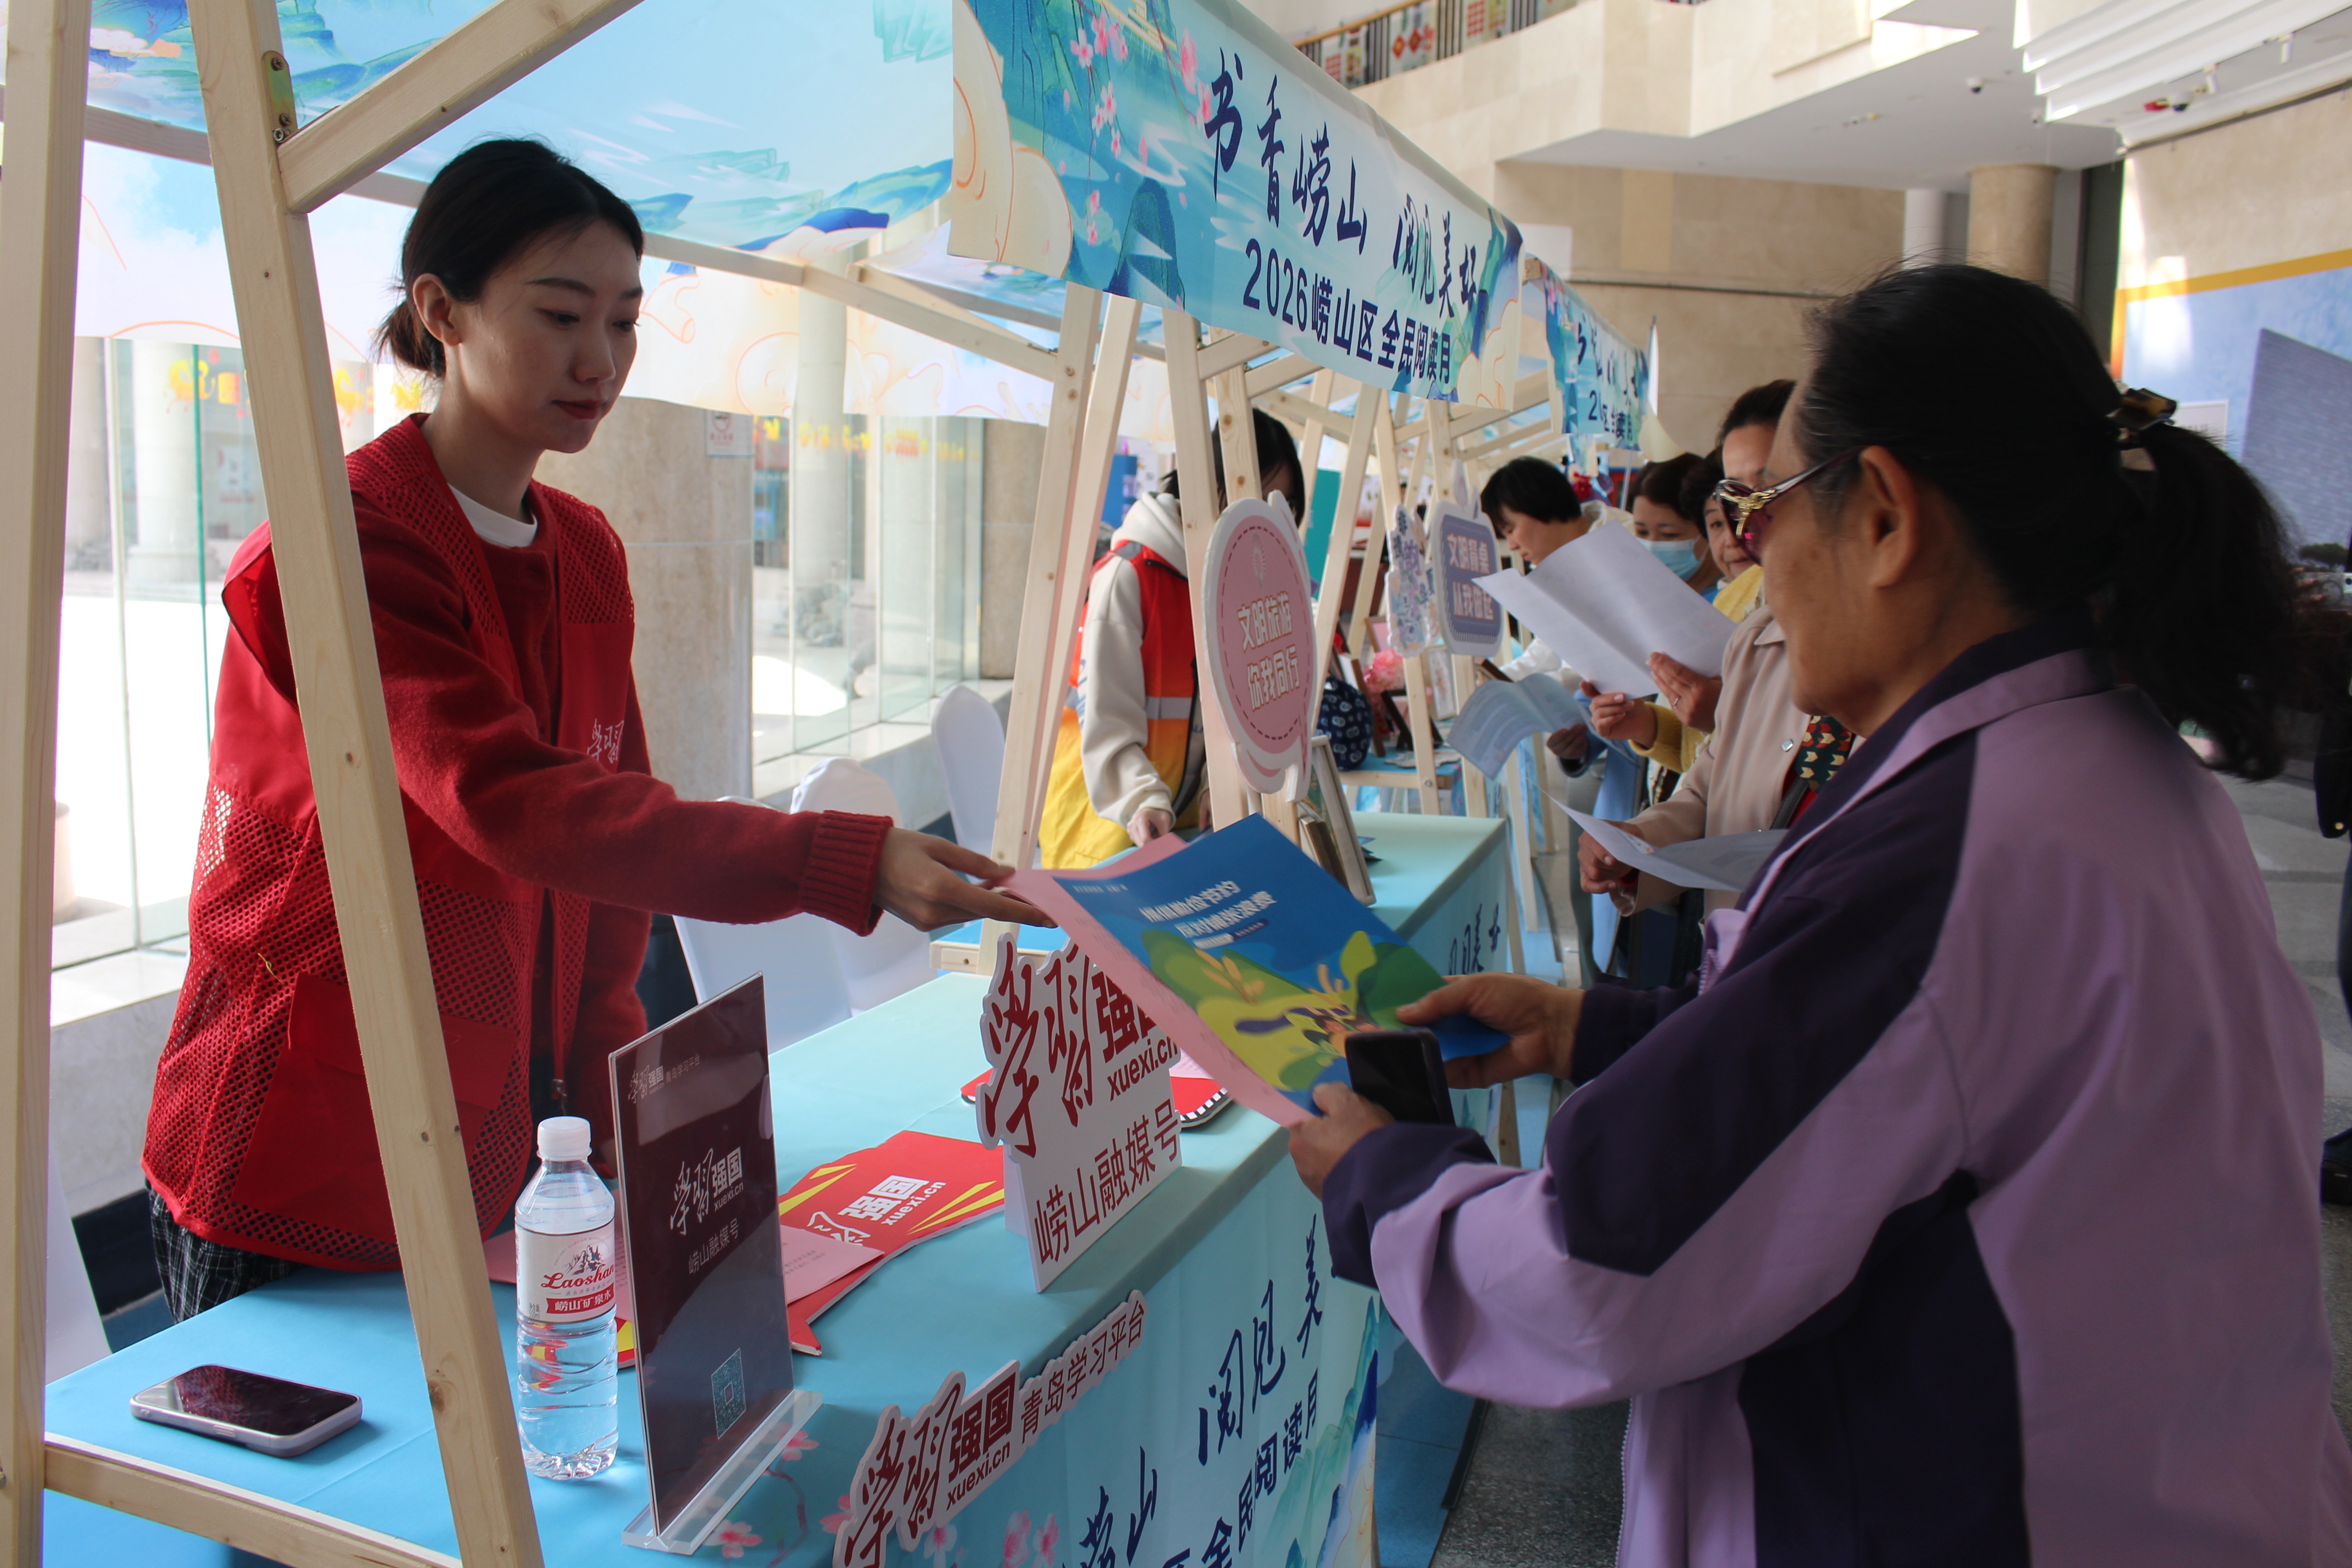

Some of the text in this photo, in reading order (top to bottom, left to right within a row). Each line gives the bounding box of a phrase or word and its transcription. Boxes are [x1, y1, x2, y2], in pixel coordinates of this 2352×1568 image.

[1205, 47, 1478, 318] 书香崂山 阅见美好
[1243, 238, 1450, 384] 2026崂山区全民阅读月
[1447, 533, 1490, 575] 文明餐桌
[1237, 591, 1292, 652] 文明旅游
[1246, 646, 1300, 711] 你我同行
[1107, 1036, 1178, 1102] xuexi.cn
[714, 1182, 744, 1212] xuexi.cn
[881, 1181, 946, 1226] xuexi.cn
[1034, 1098, 1178, 1265] 崂山融媒号
[541, 1264, 614, 1289] Laoshan
[689, 1218, 739, 1274] 崂山融媒号
[1021, 1300, 1144, 1444] 青岛学习平台
[946, 1441, 1011, 1511] xuexi.cn
[1161, 1367, 1318, 1568] 全民阅读月
